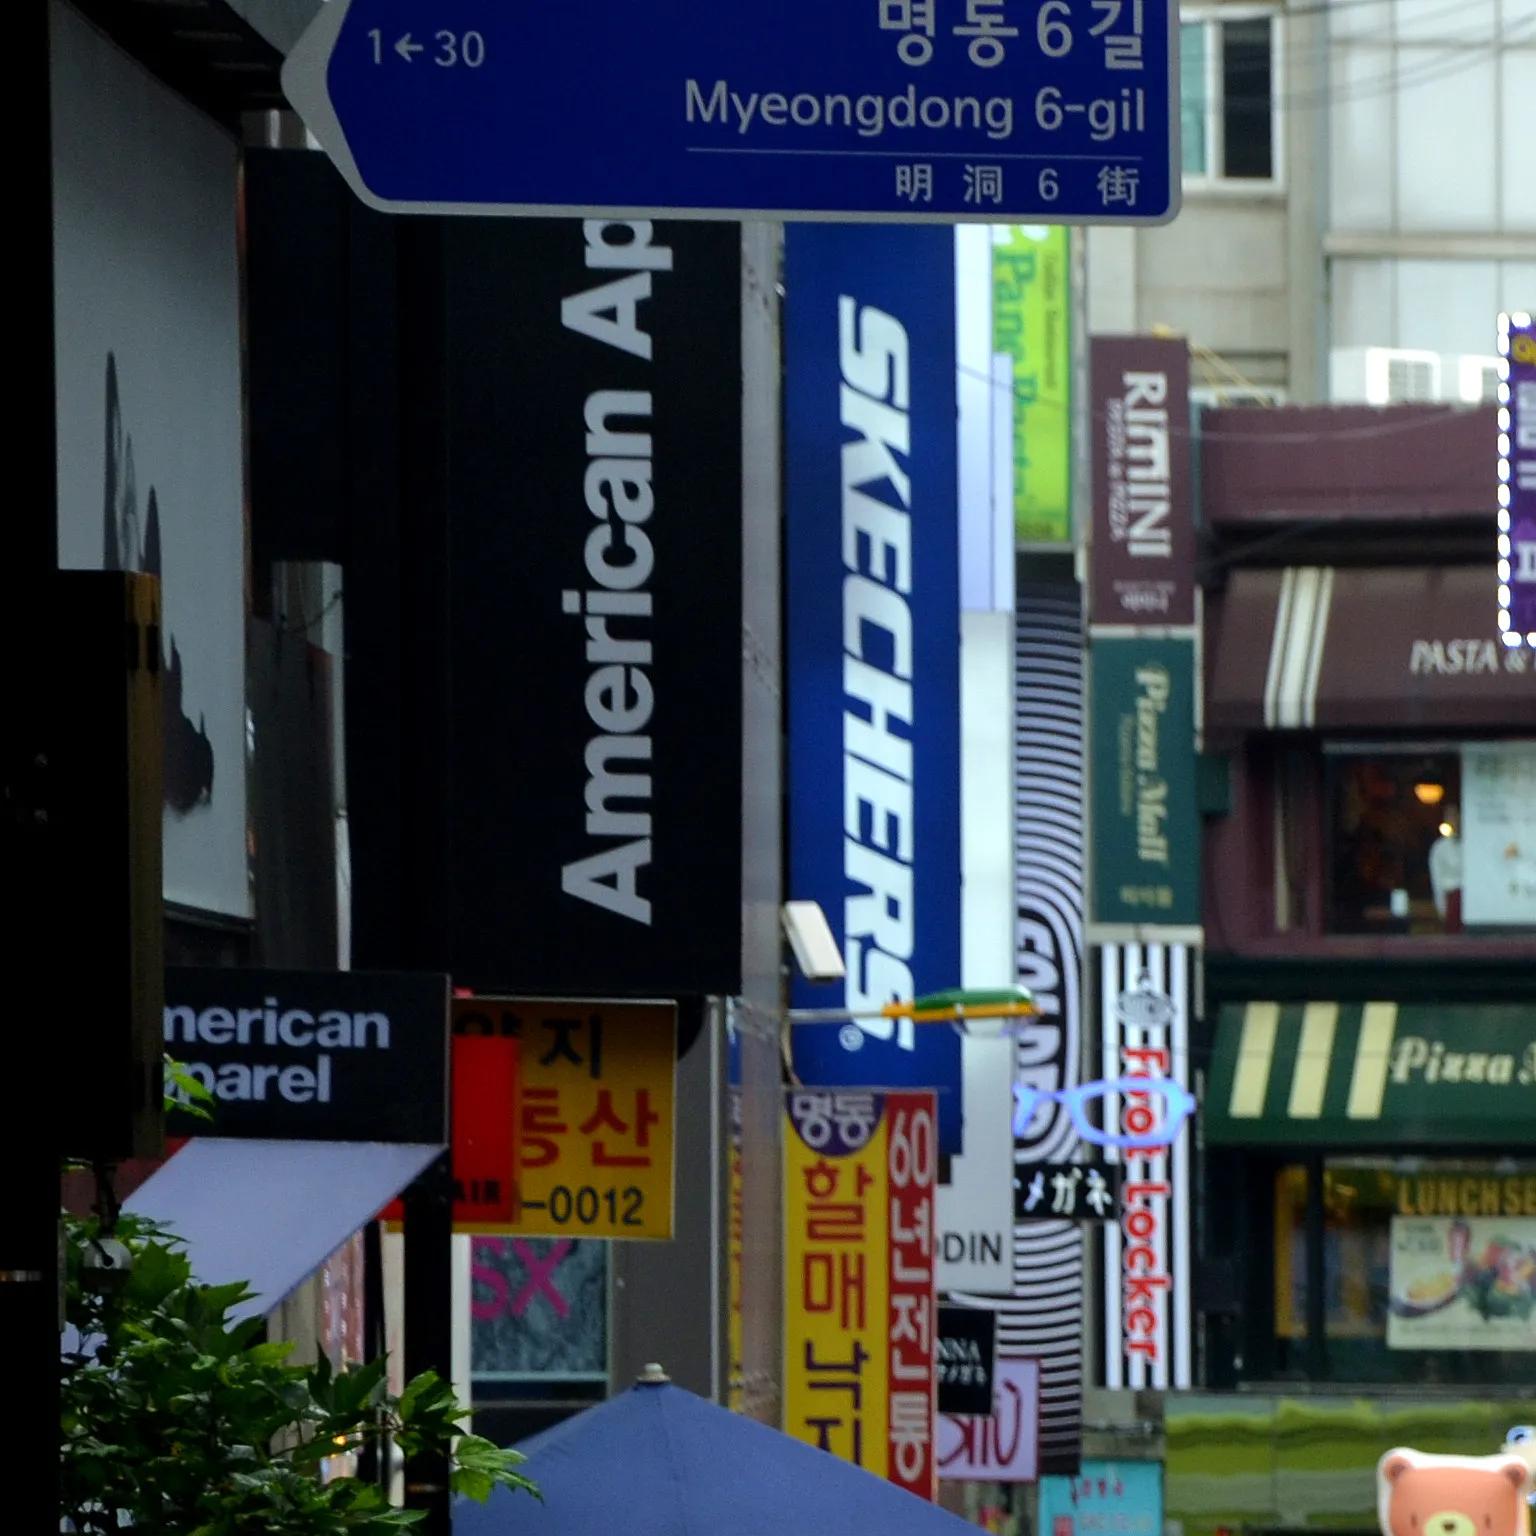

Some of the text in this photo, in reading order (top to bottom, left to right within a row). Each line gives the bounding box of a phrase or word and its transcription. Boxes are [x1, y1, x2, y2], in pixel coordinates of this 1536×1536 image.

[434, 31, 486, 68] 30
[683, 78, 1146, 139] Myeongdong 6-gil
[562, 390, 653, 924] American
[839, 295, 915, 1051] SKECHERS
[1410, 639, 1499, 672] PASTA
[164, 997, 390, 1049] merican
[1391, 1036, 1514, 1085] Pizza
[937, 1232, 1002, 1264] DIN
[1124, 1180, 1172, 1362] Locker
